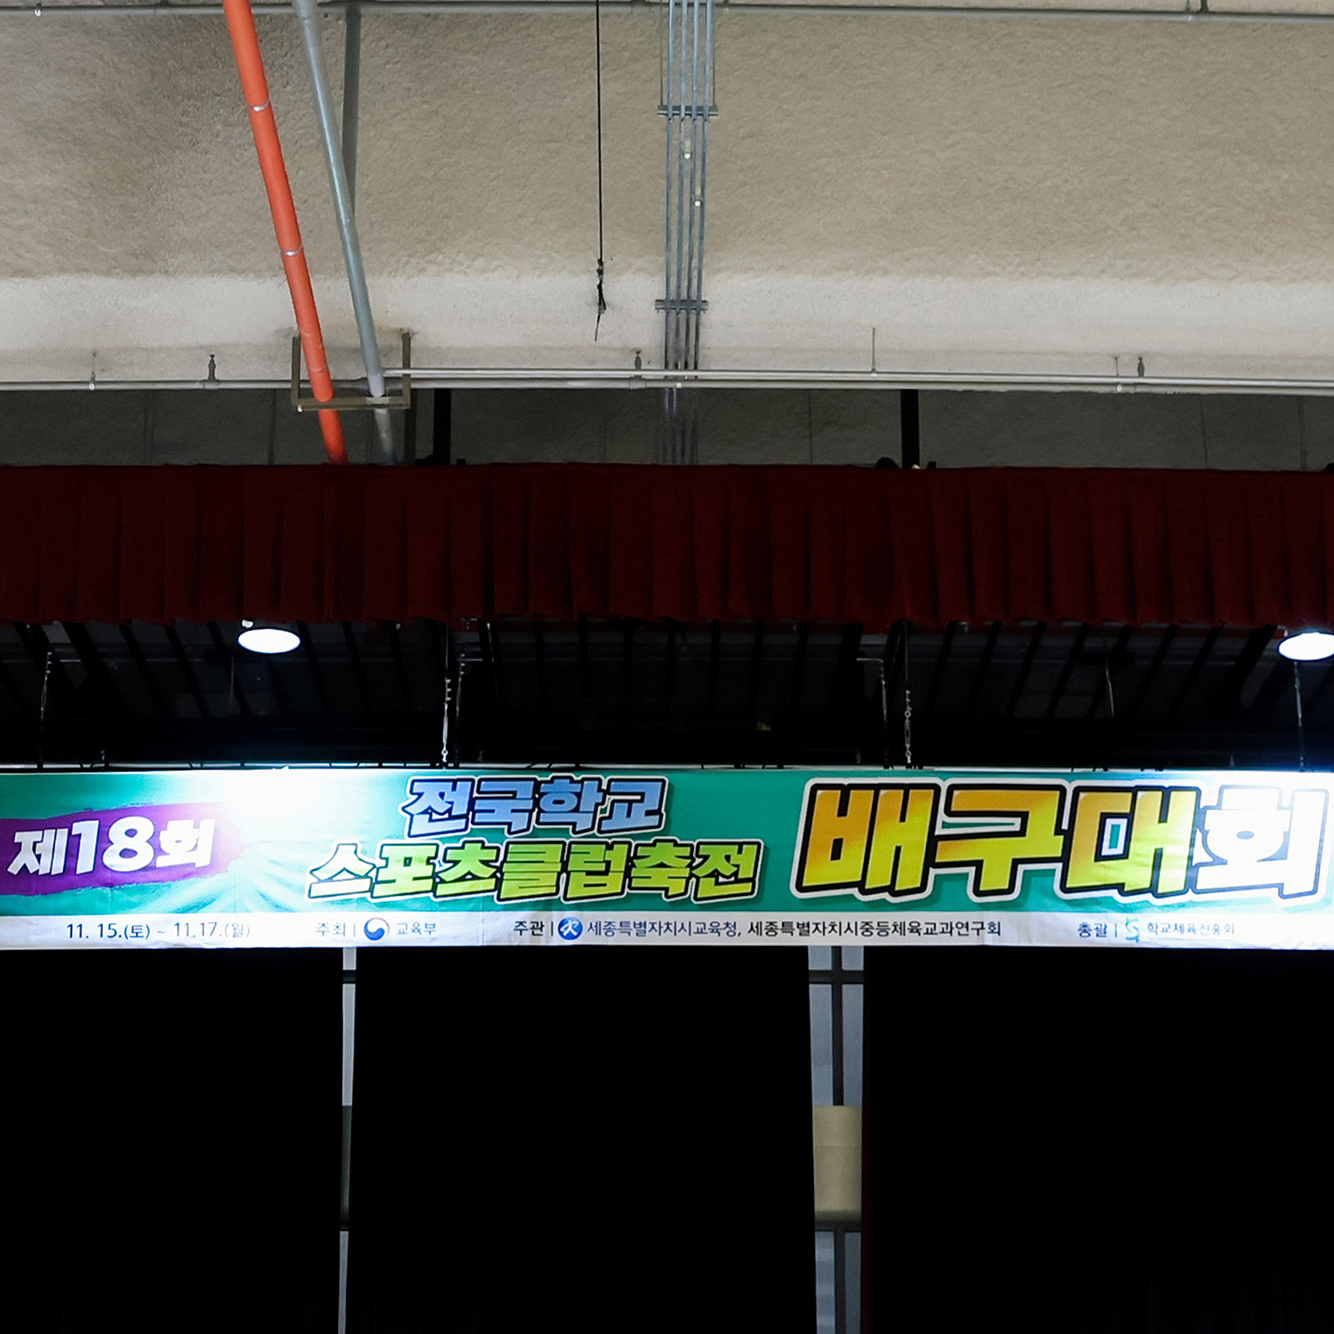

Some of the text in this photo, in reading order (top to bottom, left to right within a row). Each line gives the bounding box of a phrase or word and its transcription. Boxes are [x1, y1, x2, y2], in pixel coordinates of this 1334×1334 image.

[401, 775, 667, 838] 전국학교
[7, 816, 217, 877] 제18회
[793, 779, 1333, 901] 배구대회
[307, 842, 763, 902] 스포츠클럽축전
[315, 921, 437, 938] 주최 교육부
[513, 920, 546, 938] 주관
[747, 919, 1002, 938] 세종특별자치시중등체육교과연구회
[1077, 921, 1108, 938] 총괄
